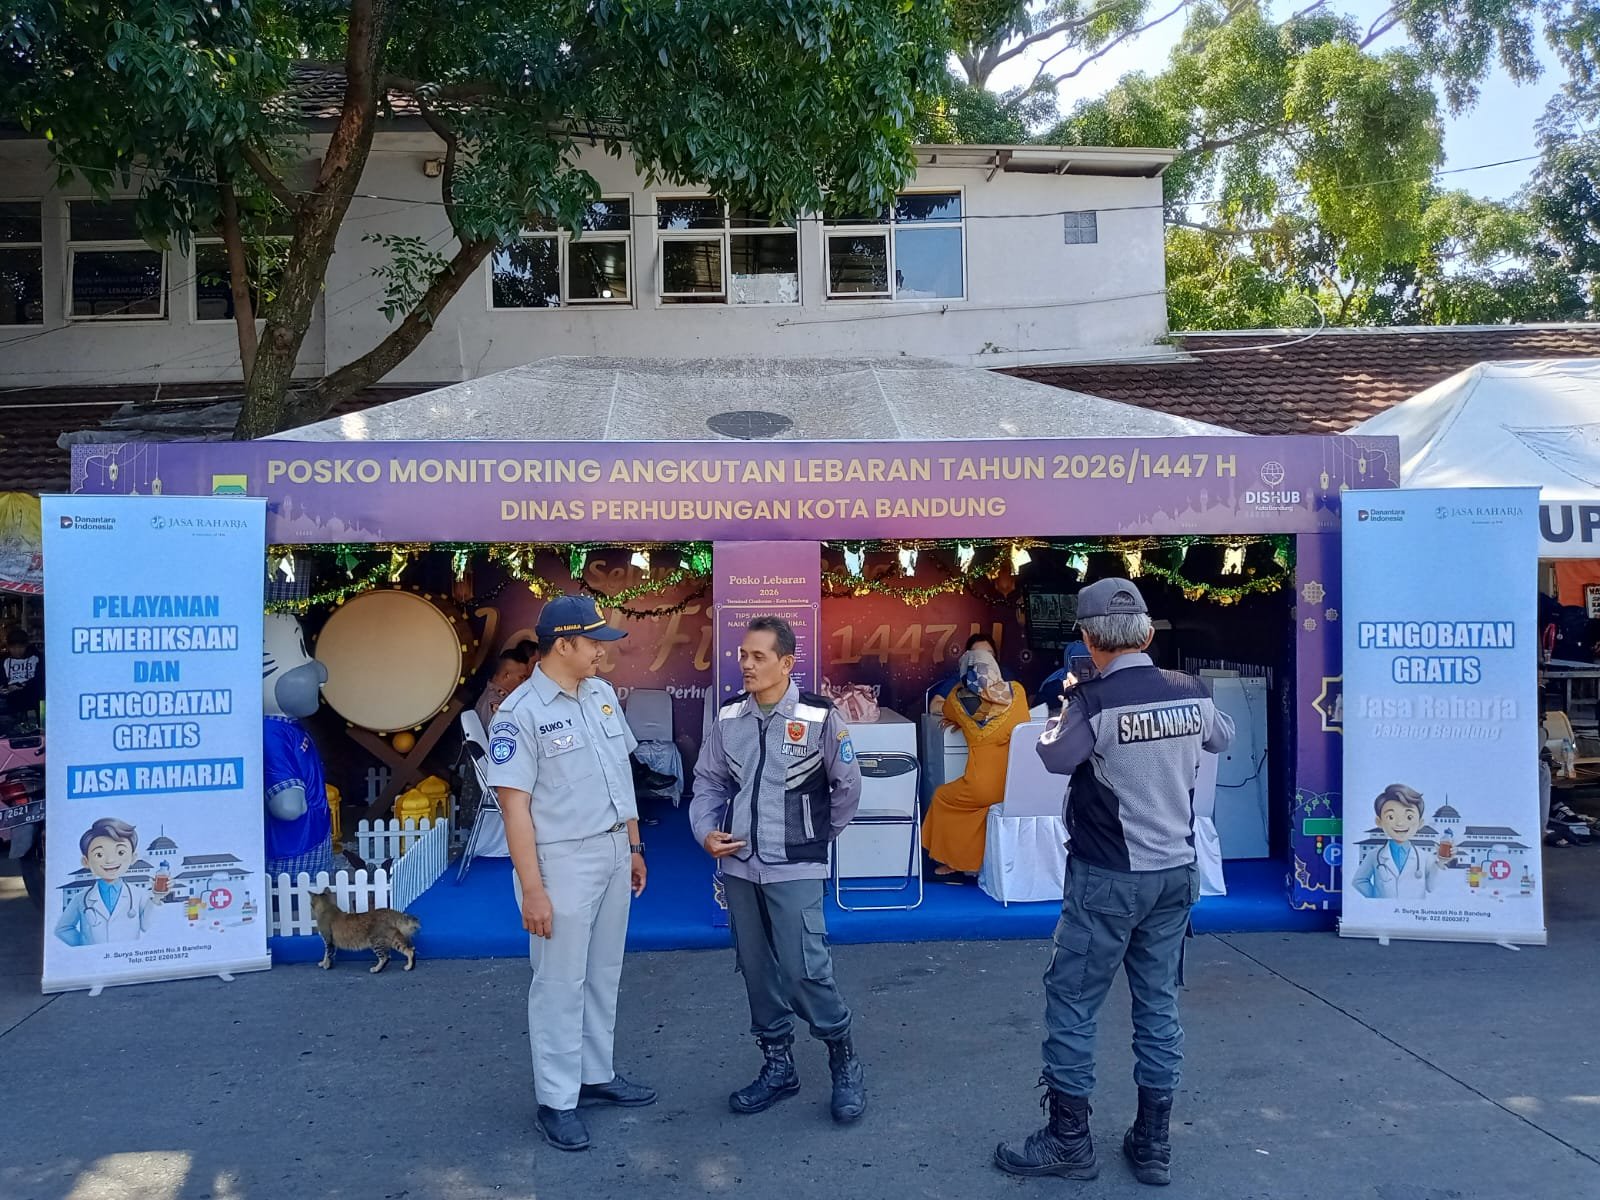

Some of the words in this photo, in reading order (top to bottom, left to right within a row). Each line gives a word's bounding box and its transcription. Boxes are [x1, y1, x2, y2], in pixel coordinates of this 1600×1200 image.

[267, 459, 382, 484] POSKO
[389, 459, 601, 483] MONITORING
[608, 459, 786, 483] ANGKUTAN
[794, 458, 931, 483] LEBARAN
[938, 456, 1045, 480] TAHUN
[1052, 448, 1209, 484] 2026/1447
[1216, 454, 1237, 478] H
[501, 500, 585, 521] DINAS
[591, 499, 791, 521] PERHUBUNGAN
[798, 498, 869, 520] KOTA
[875, 496, 1007, 519] BANDUNG
[1245, 491, 1301, 504] DISHUB
[74, 515, 117, 524] Danantara
[1370, 508, 1406, 516] Danantara
[1451, 507, 1473, 517] JASA
[1476, 506, 1524, 517] RAHARJA
[74, 522, 115, 531] Indonesia
[168, 518, 193, 529] JASA
[195, 518, 249, 530] RAHARJA
[728, 575, 760, 585] Posko
[763, 575, 807, 585] Lebaran
[92, 595, 220, 618] PELAYANAN
[72, 625, 239, 653] PEMERIKSAAN
[830, 623, 957, 666] 1447
[1359, 621, 1515, 649] PENGOBATAN
[133, 660, 180, 683] DAN
[1392, 656, 1482, 684] GRATIS
[79, 688, 232, 720] PENGOBATAN
[1359, 694, 1413, 719] Jasa
[1419, 694, 1518, 721] Raharja
[539, 720, 564, 735] SUKO
[566, 718, 573, 728] Y
[1120, 705, 1201, 742] SATLINMAS
[1374, 723, 1431, 740] Cabang
[1434, 723, 1501, 740] Bandung
[113, 722, 201, 751] GRATIS
[72, 767, 130, 794] JASA
[135, 762, 237, 790] RAHARJA
[8, 805, 28, 818] 2621
[182, 944, 212, 952] Bandung
